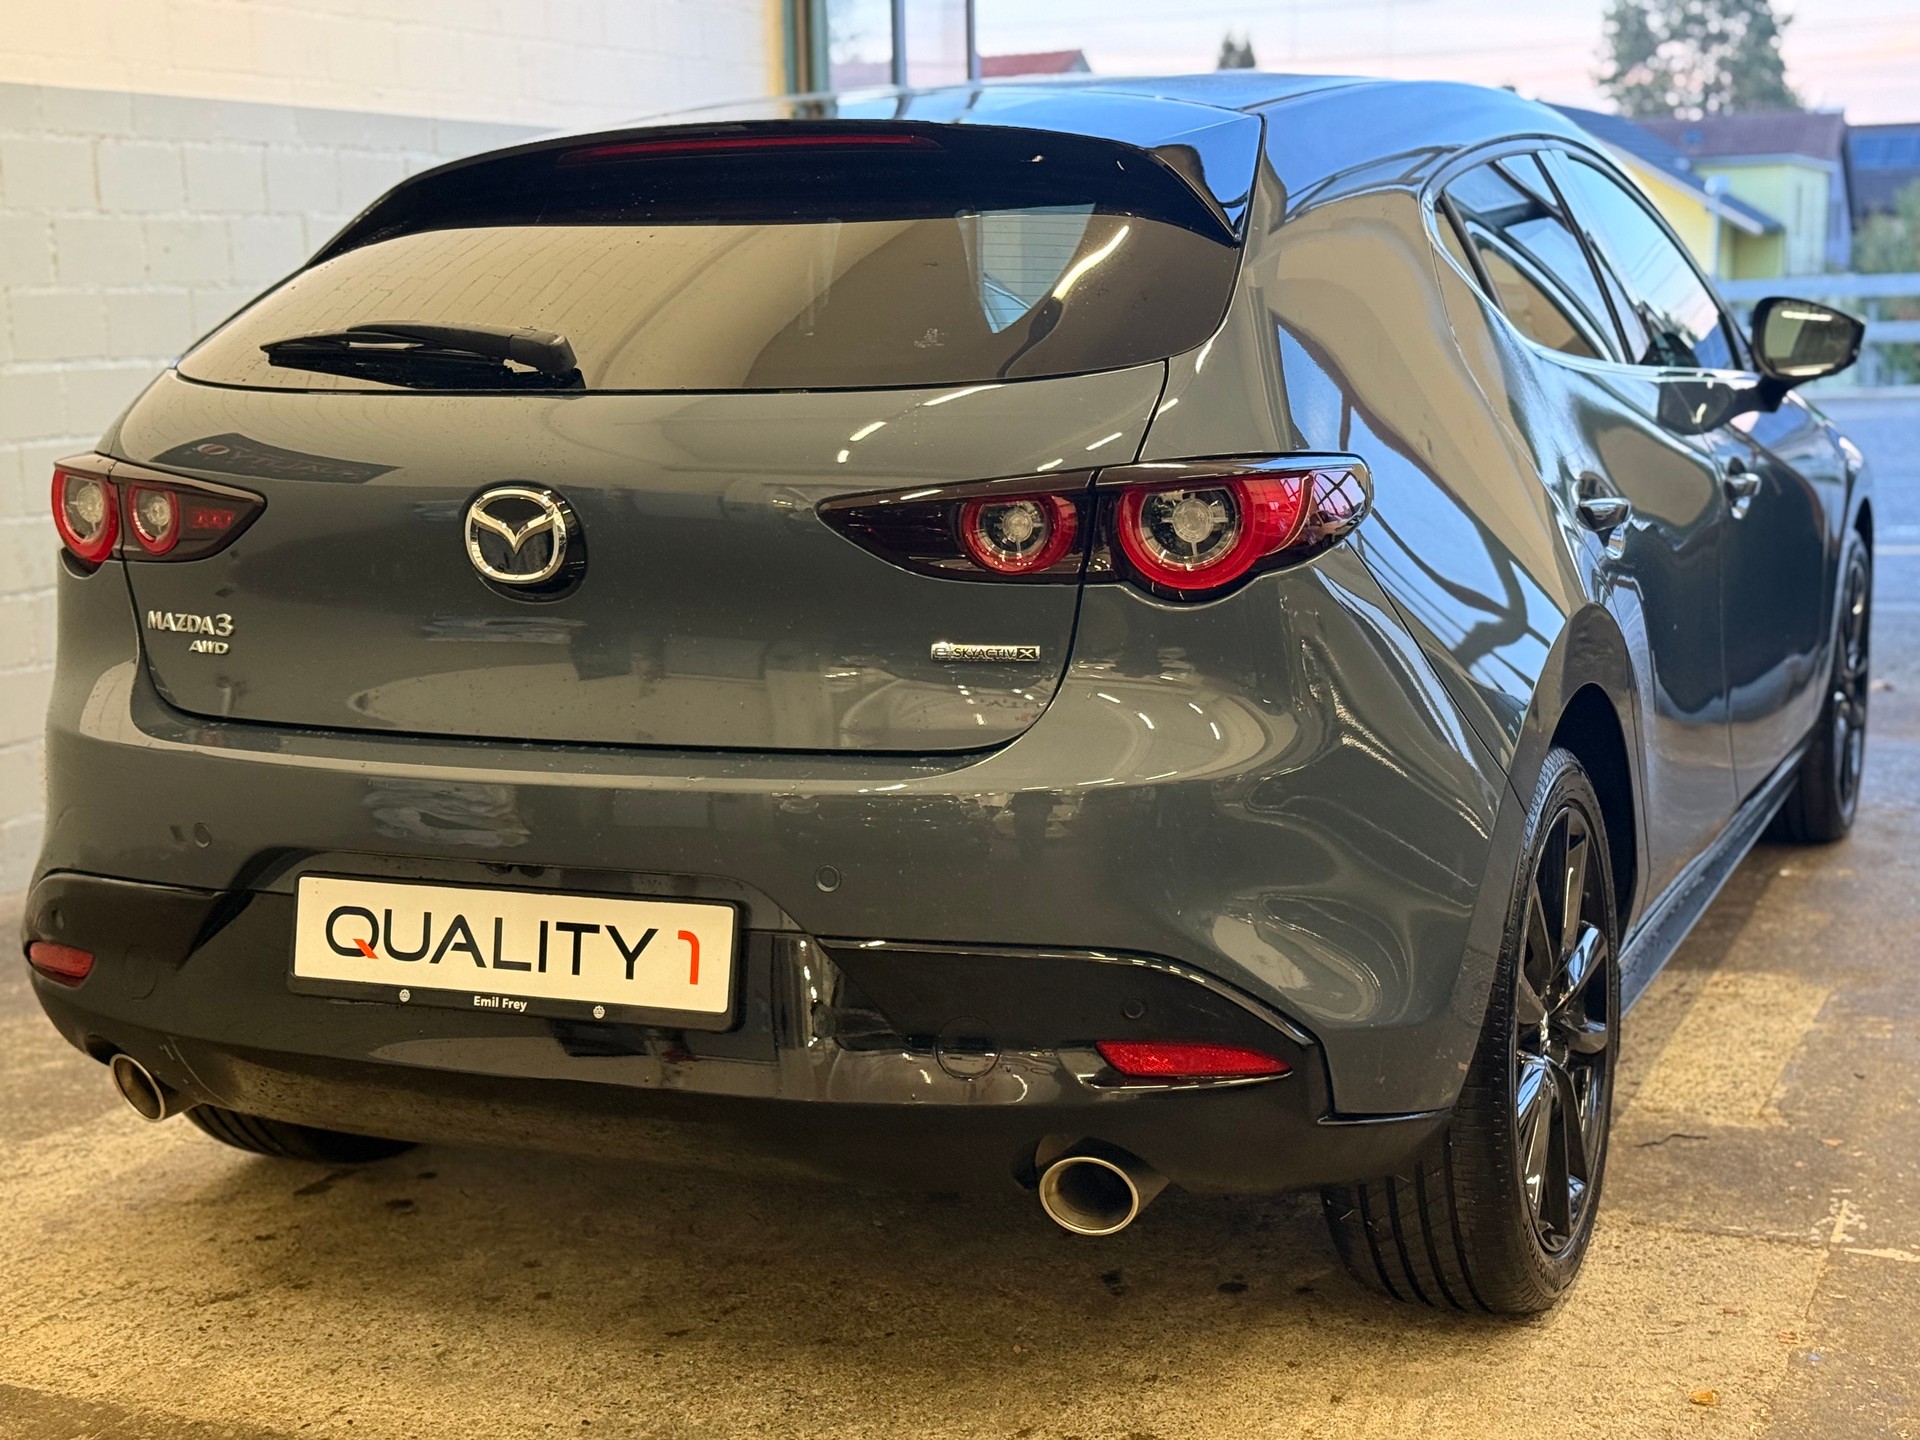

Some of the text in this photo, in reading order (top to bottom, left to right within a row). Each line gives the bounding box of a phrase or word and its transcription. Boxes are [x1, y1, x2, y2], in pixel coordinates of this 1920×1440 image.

[188, 640, 229, 655] AWD
[325, 905, 700, 985] QUALITY 1
[473, 995, 528, 1013] Emil Frey
